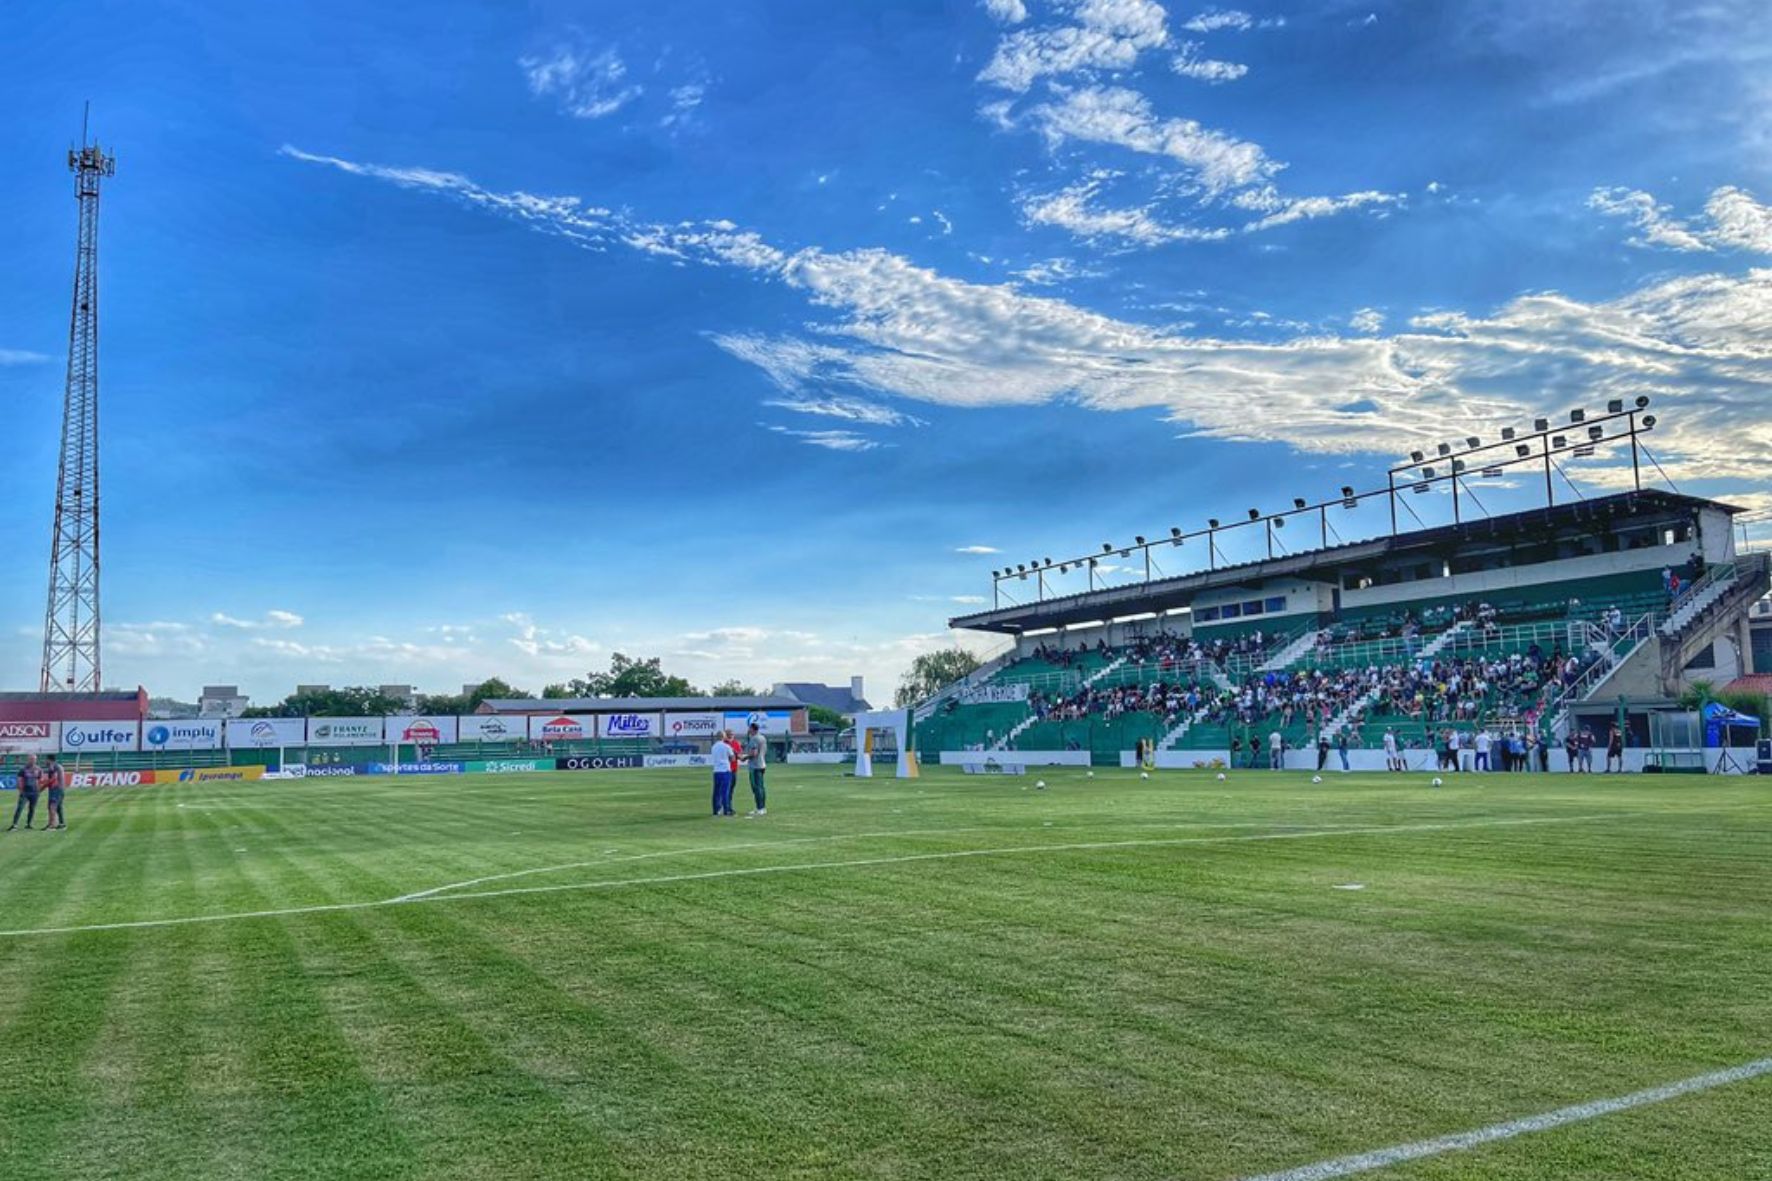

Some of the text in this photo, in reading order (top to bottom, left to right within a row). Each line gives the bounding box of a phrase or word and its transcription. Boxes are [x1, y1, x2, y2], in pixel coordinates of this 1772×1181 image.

[88, 729, 133, 743] ulfer
[172, 727, 215, 738] imply
[500, 761, 536, 771] Sicredi
[567, 757, 633, 769] OGOCHI
[70, 771, 140, 788] BETANO
